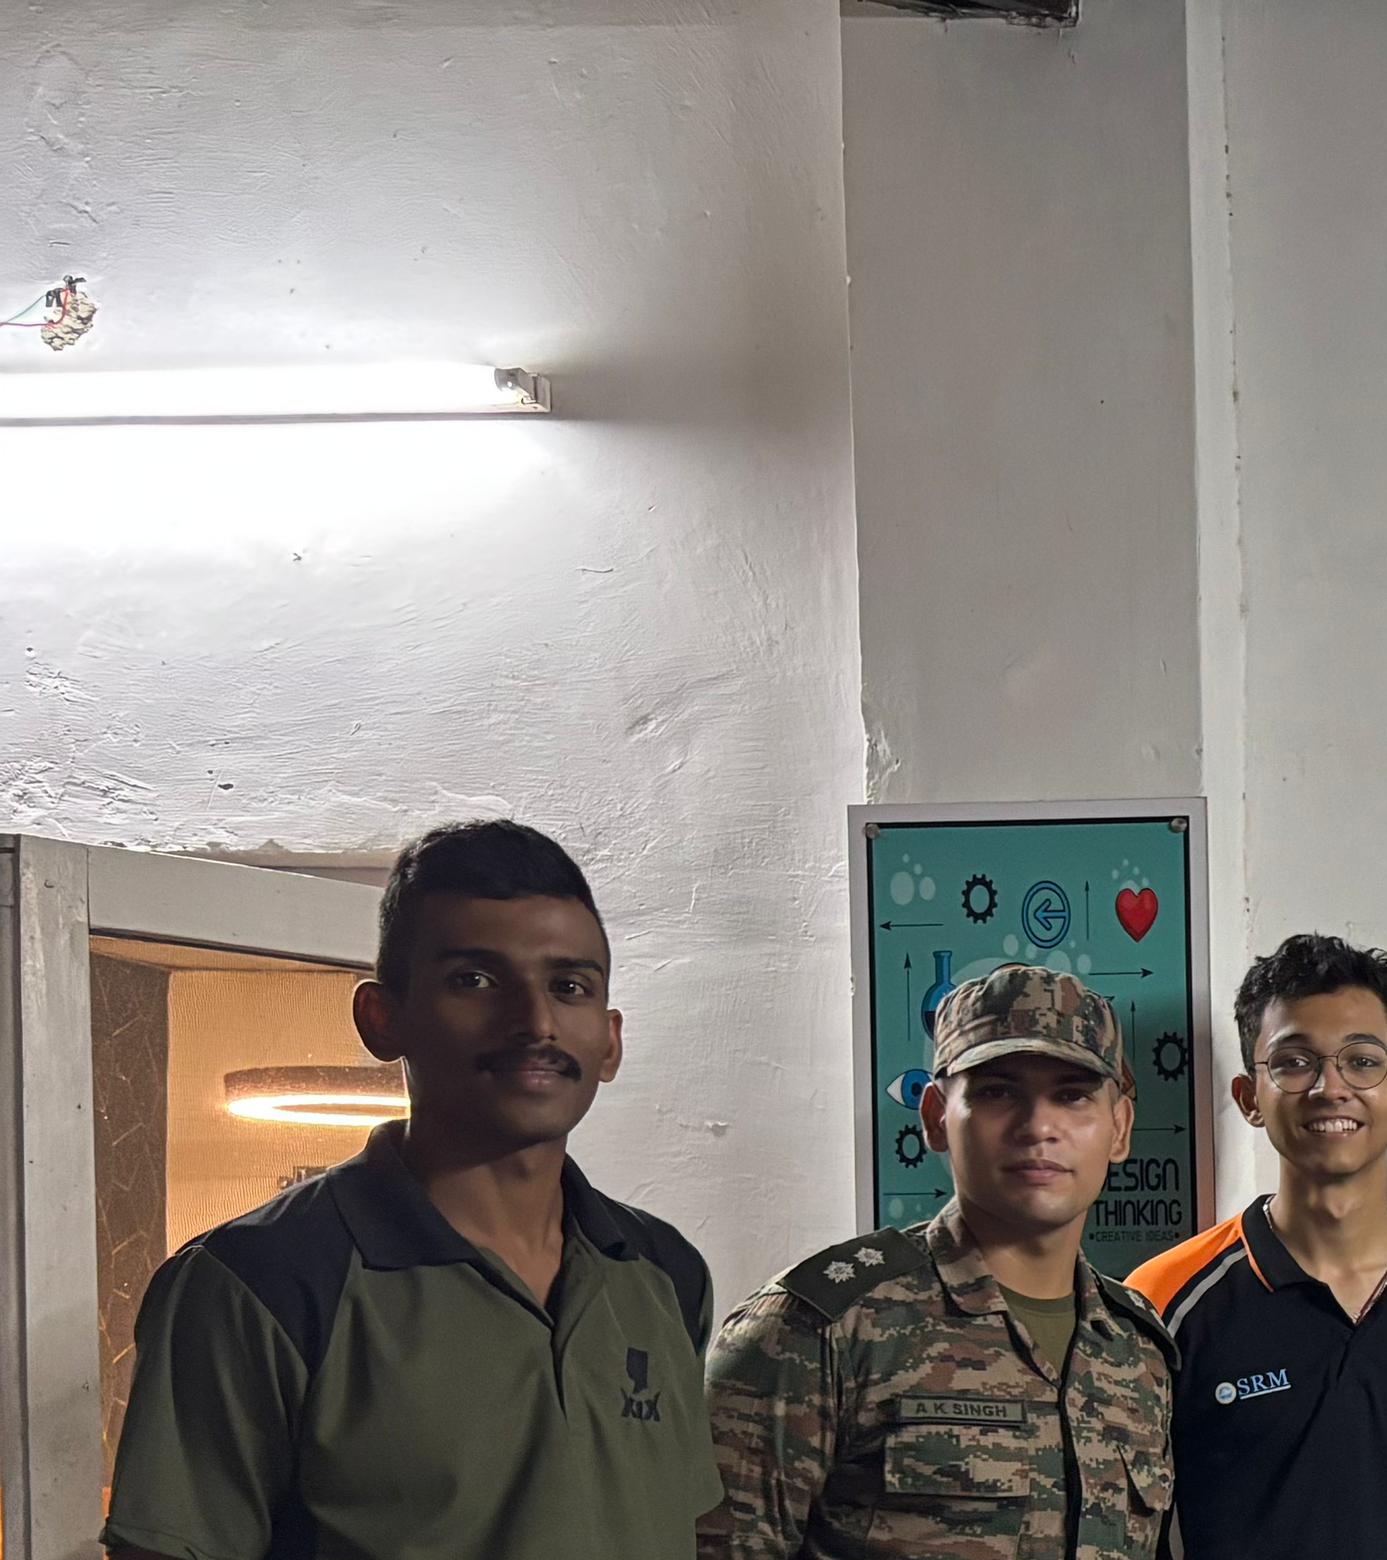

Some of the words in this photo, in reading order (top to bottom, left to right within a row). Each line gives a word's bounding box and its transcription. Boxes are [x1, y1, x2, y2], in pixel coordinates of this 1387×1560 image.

[1101, 1158, 1180, 1192] ESIGN
[1093, 1199, 1182, 1227] THINKING
[1237, 1368, 1289, 1396] SRM
[952, 1402, 1007, 1418] SINGH
